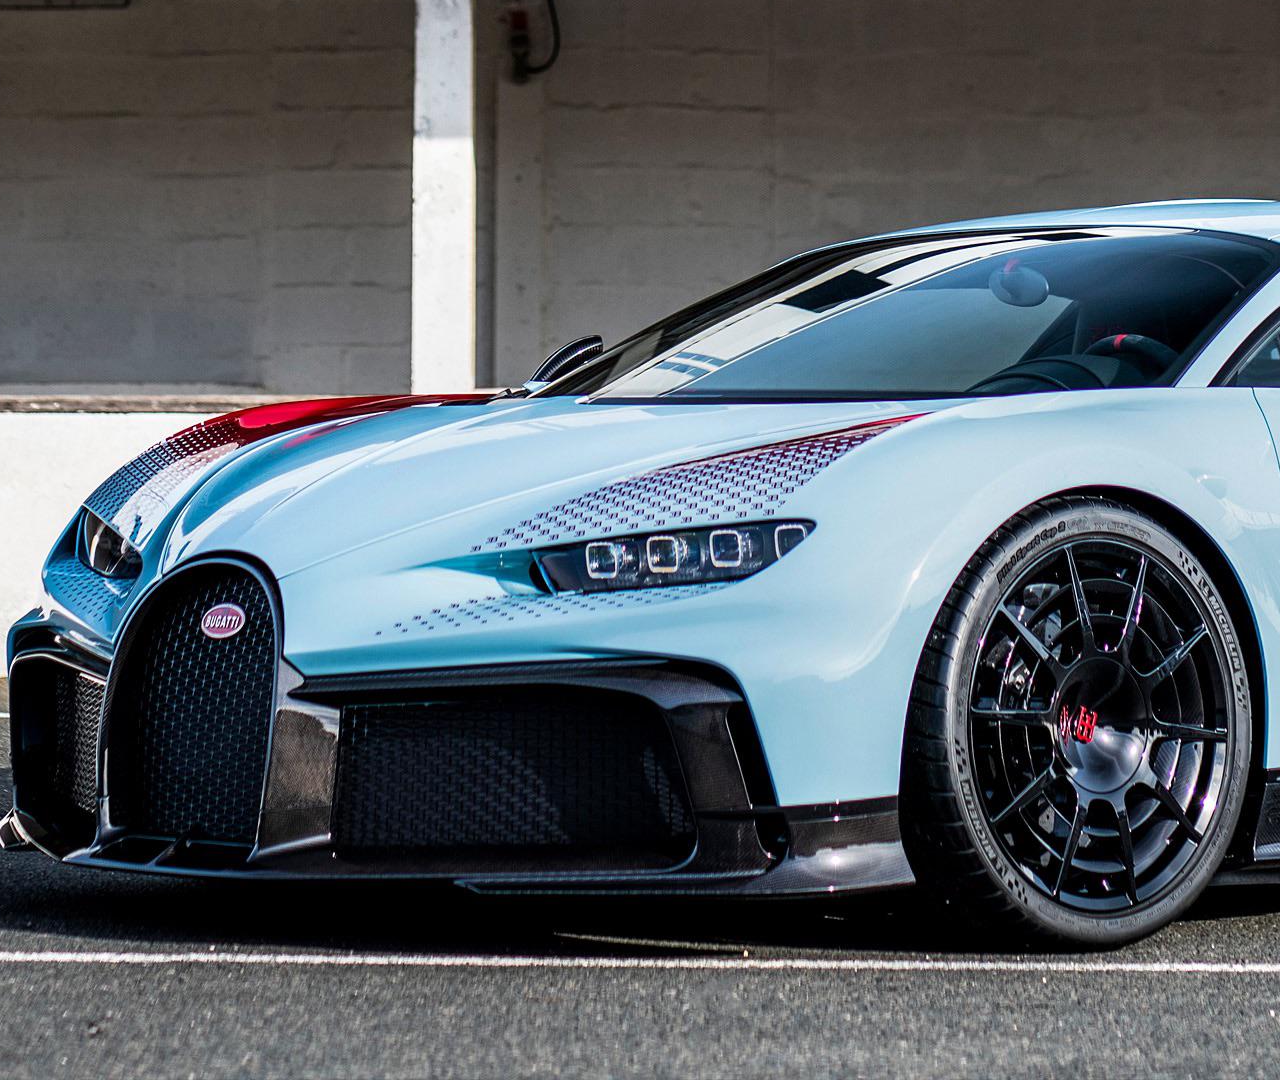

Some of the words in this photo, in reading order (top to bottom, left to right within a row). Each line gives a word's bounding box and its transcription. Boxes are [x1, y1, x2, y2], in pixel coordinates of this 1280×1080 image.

[1040, 528, 1058, 541] Cup
[205, 614, 241, 629] BUGATTI
[1208, 594, 1241, 671] MICHELIN
[960, 780, 998, 860] MICHELIN
